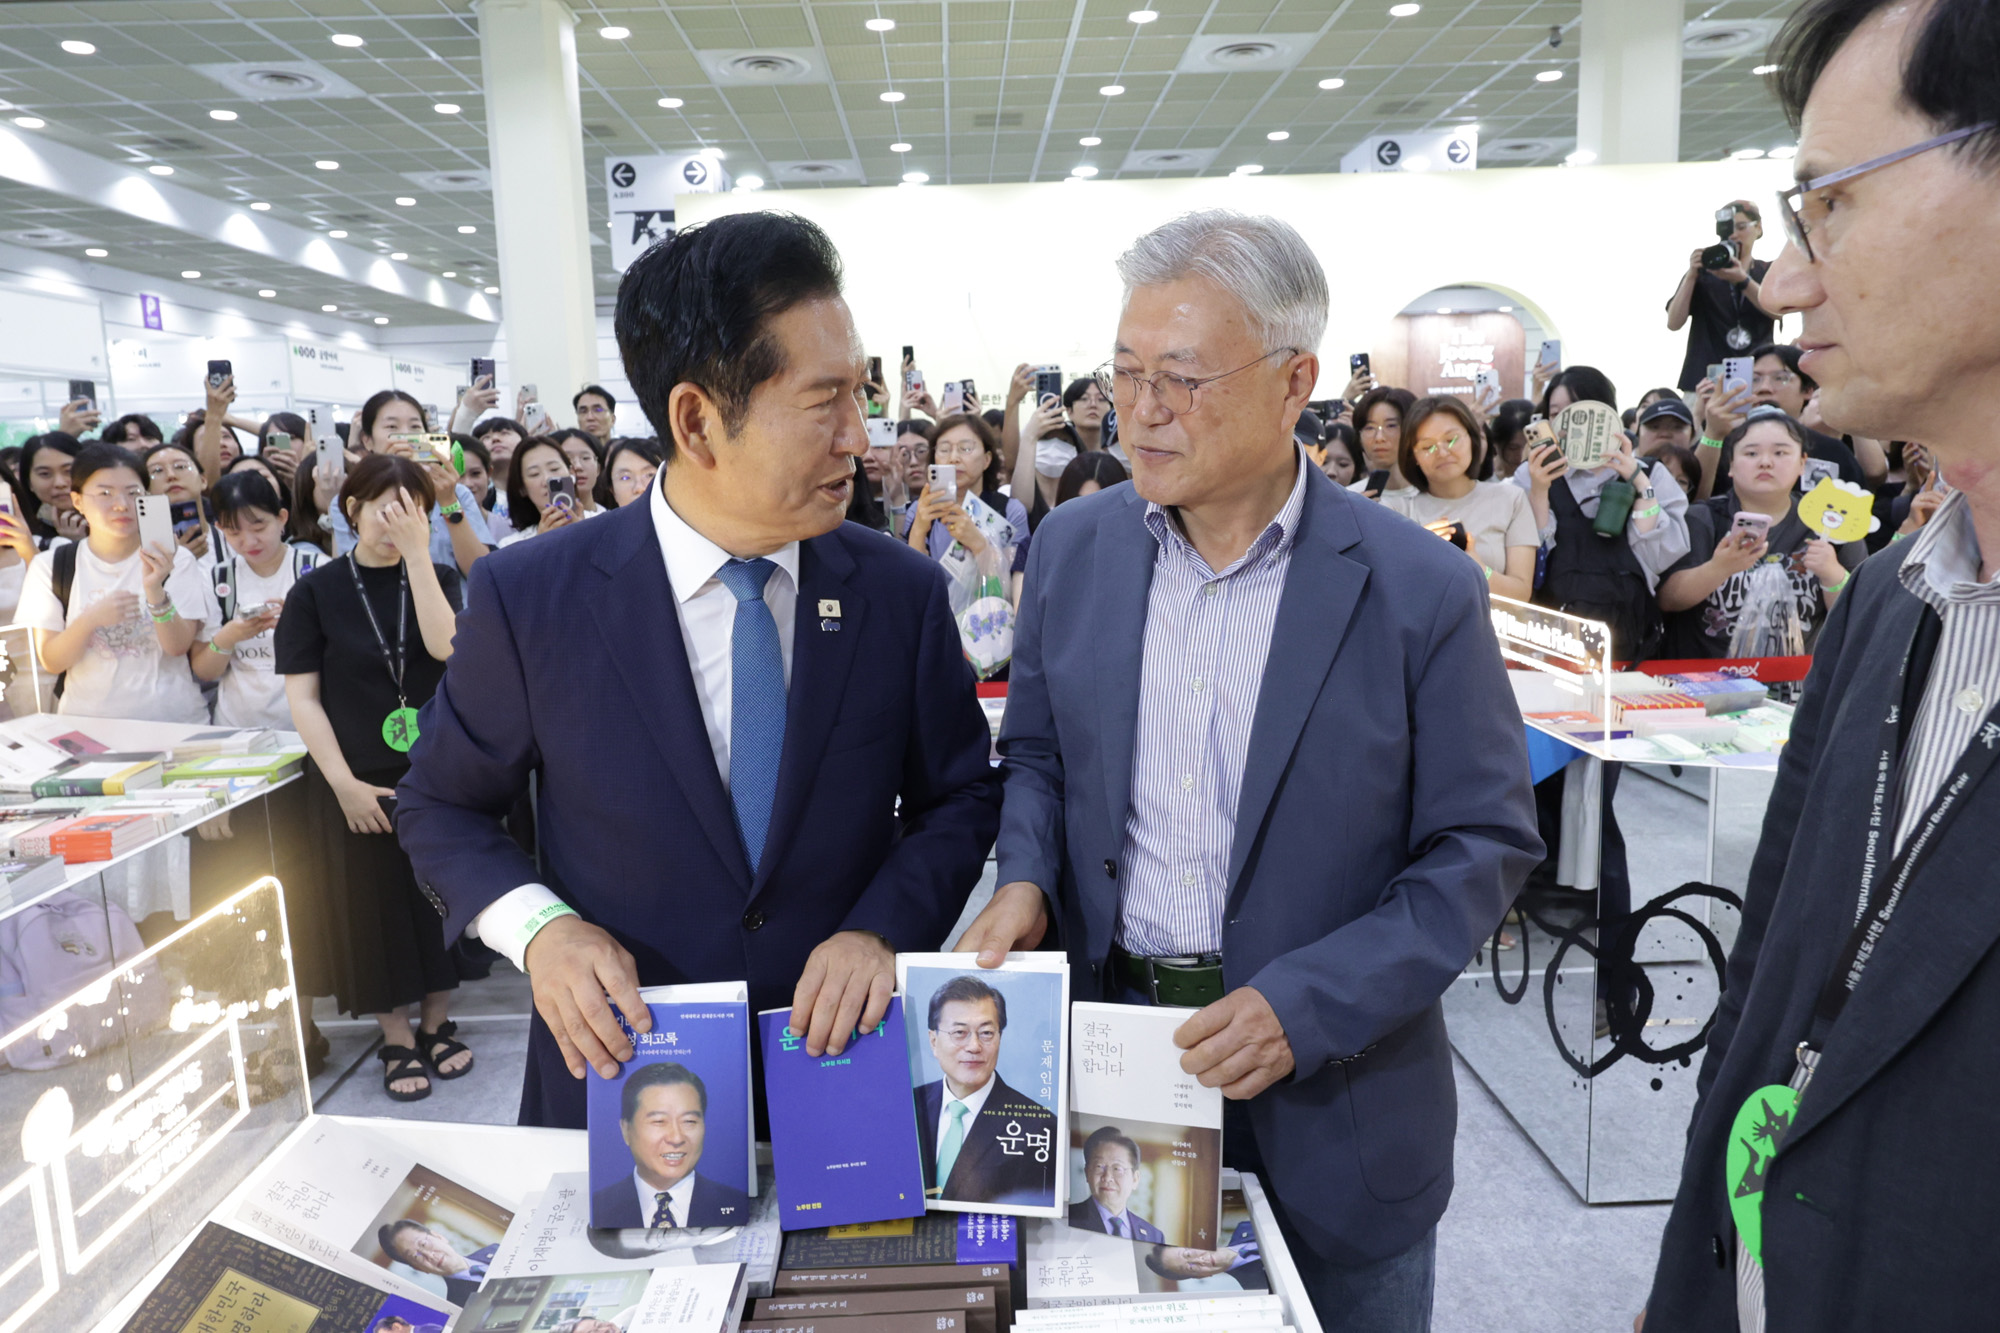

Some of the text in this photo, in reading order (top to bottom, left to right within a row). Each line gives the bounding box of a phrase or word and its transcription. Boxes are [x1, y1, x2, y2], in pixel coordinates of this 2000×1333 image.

[1868, 750, 1889, 827] 서울국제도서전
[1866, 831, 1879, 861] Seoul
[1845, 772, 1970, 992] 서울국제도서전 Seoul International Book Fair
[640, 1032, 679, 1046] 회고록
[1082, 1021, 1112, 1038] 결국
[1081, 1040, 1124, 1059] 국민이
[1039, 1039, 1054, 1101] 문재인의
[1081, 1058, 1125, 1077] 합니다
[996, 1120, 1051, 1163] 운명
[266, 1180, 290, 1203] 결국
[283, 1181, 317, 1212] 국민이
[302, 1190, 335, 1221] 합니다
[558, 1188, 577, 1200] 팔
[547, 1202, 570, 1224] 굽은
[250, 1208, 341, 1262] 결국 국민이 합니다
[529, 1227, 556, 1271] 이재명의
[1038, 1265, 1054, 1287] 결국
[1057, 1256, 1075, 1287] 국민이
[1076, 1254, 1094, 1287] 합니다
[231, 1292, 272, 1333] 명하라
[1163, 1316, 1187, 1324] 위로
[1166, 1303, 1188, 1311] 위로
